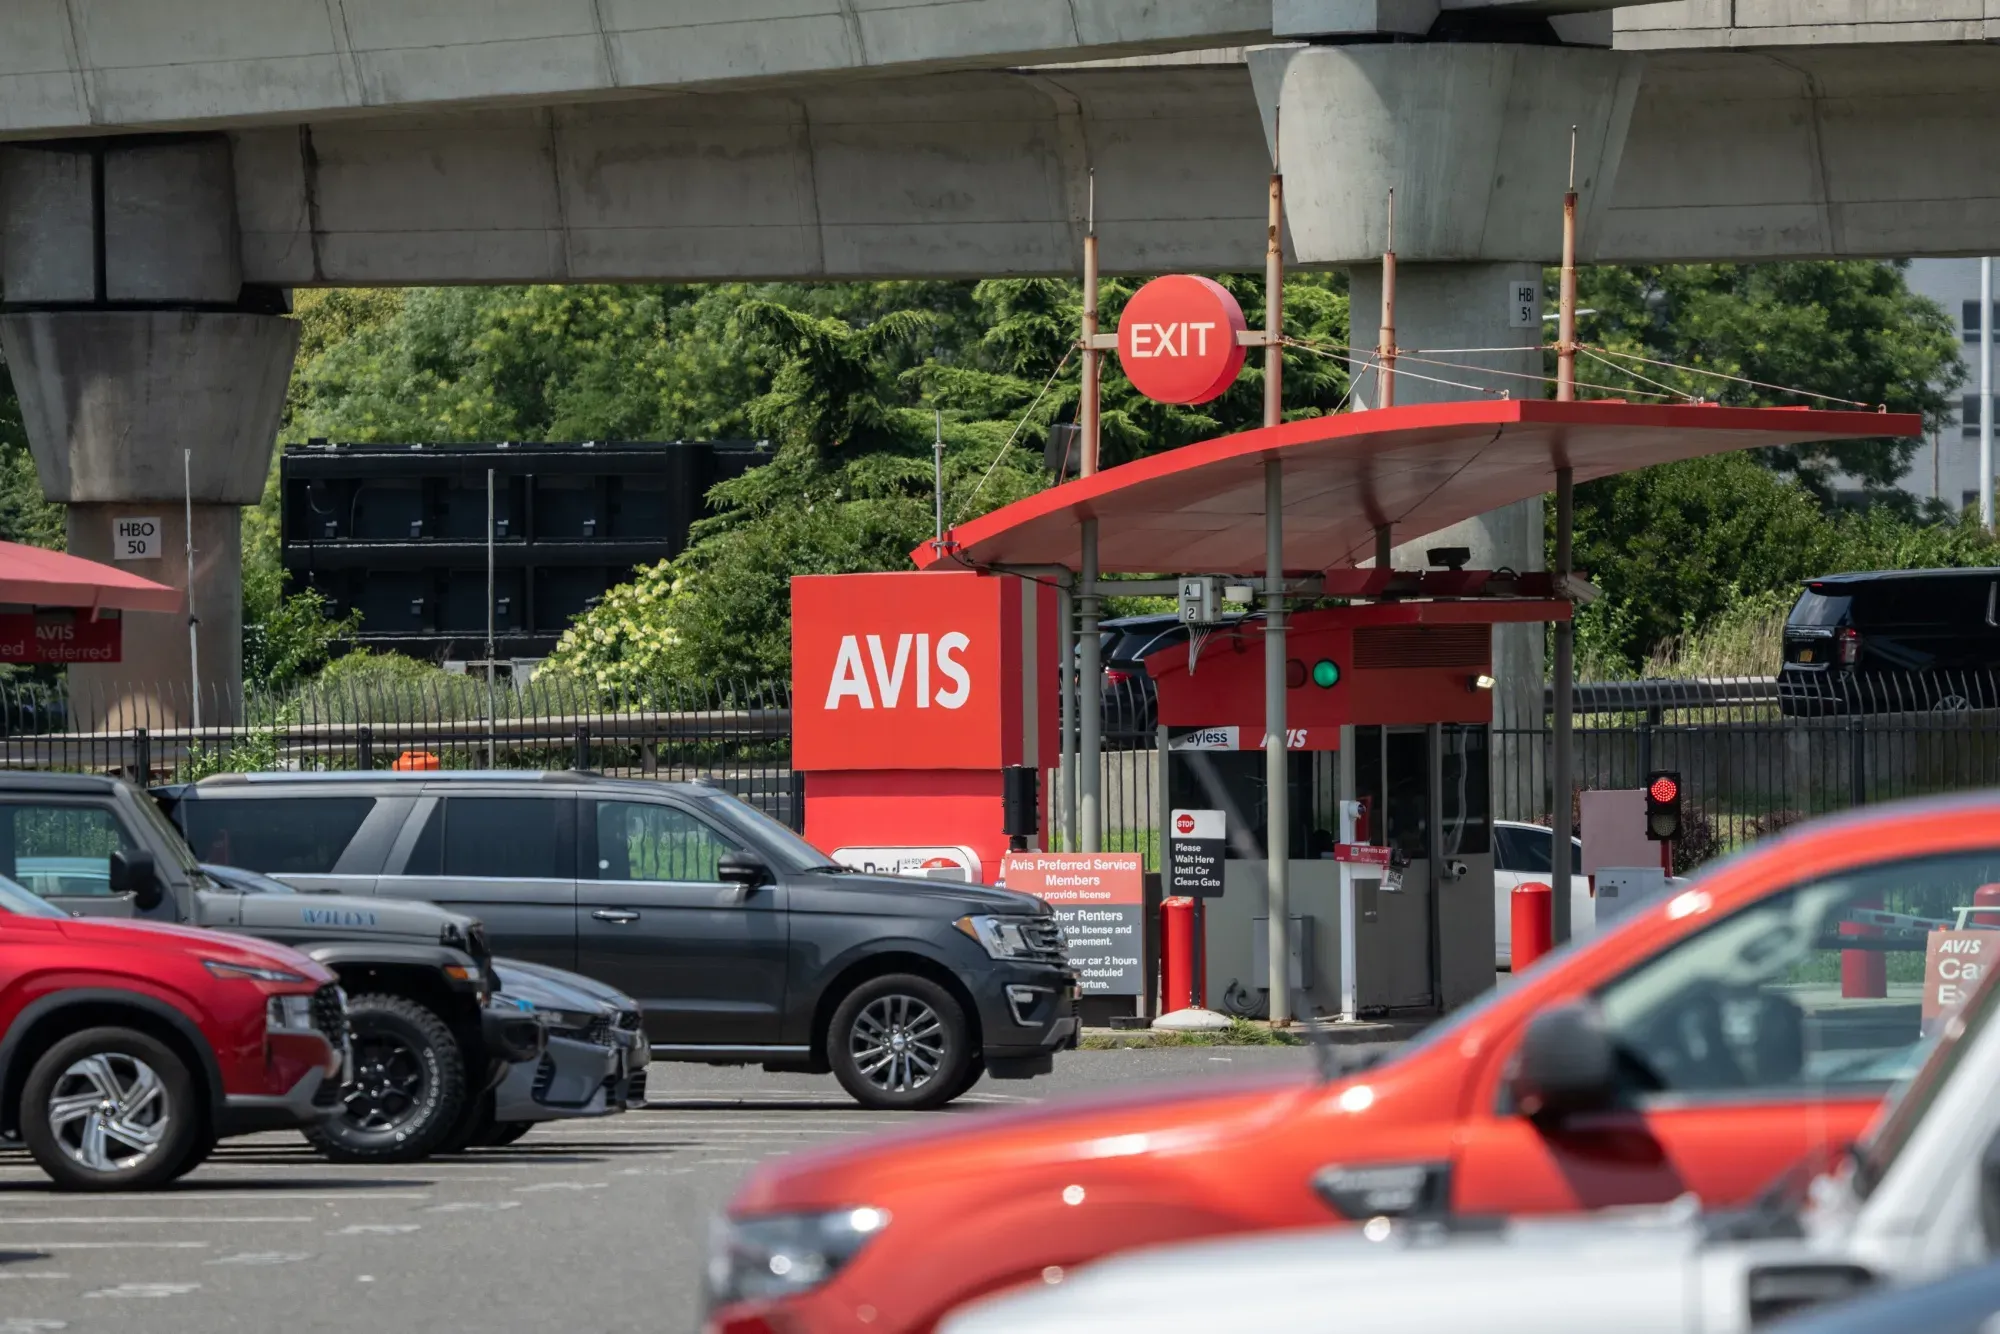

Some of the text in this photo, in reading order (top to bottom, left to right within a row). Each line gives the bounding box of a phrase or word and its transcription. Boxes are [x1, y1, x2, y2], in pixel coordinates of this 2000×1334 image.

[1521, 306, 1532, 321] 51
[1131, 322, 1216, 358] EXIT
[119, 522, 155, 537] HBO
[127, 540, 147, 554] 50
[1184, 584, 1191, 596] A
[1188, 607, 1195, 619] 2
[824, 631, 971, 710] AVIS
[1187, 730, 1228, 746] ayless
[1177, 820, 1194, 828] STOP
[1175, 843, 1201, 852] Please
[1010, 859, 1137, 871] Avis Preferred Service
[1175, 855, 1215, 864] Wait Here
[1174, 866, 1209, 875] Until Car
[1045, 874, 1101, 887] Members
[1174, 877, 1221, 887] Clears Gate
[1043, 890, 1078, 902] provide
[1079, 890, 1111, 899] license
[1077, 909, 1123, 922] Renters
[1081, 925, 1113, 935] license
[1114, 925, 1133, 935] and
[1067, 937, 1113, 948] greement.
[1939, 939, 1981, 954] AVIS
[1087, 957, 1103, 966] car
[1104, 955, 1111, 966] 2
[1112, 955, 1138, 966] hours
[1081, 968, 1124, 978] cheduled
